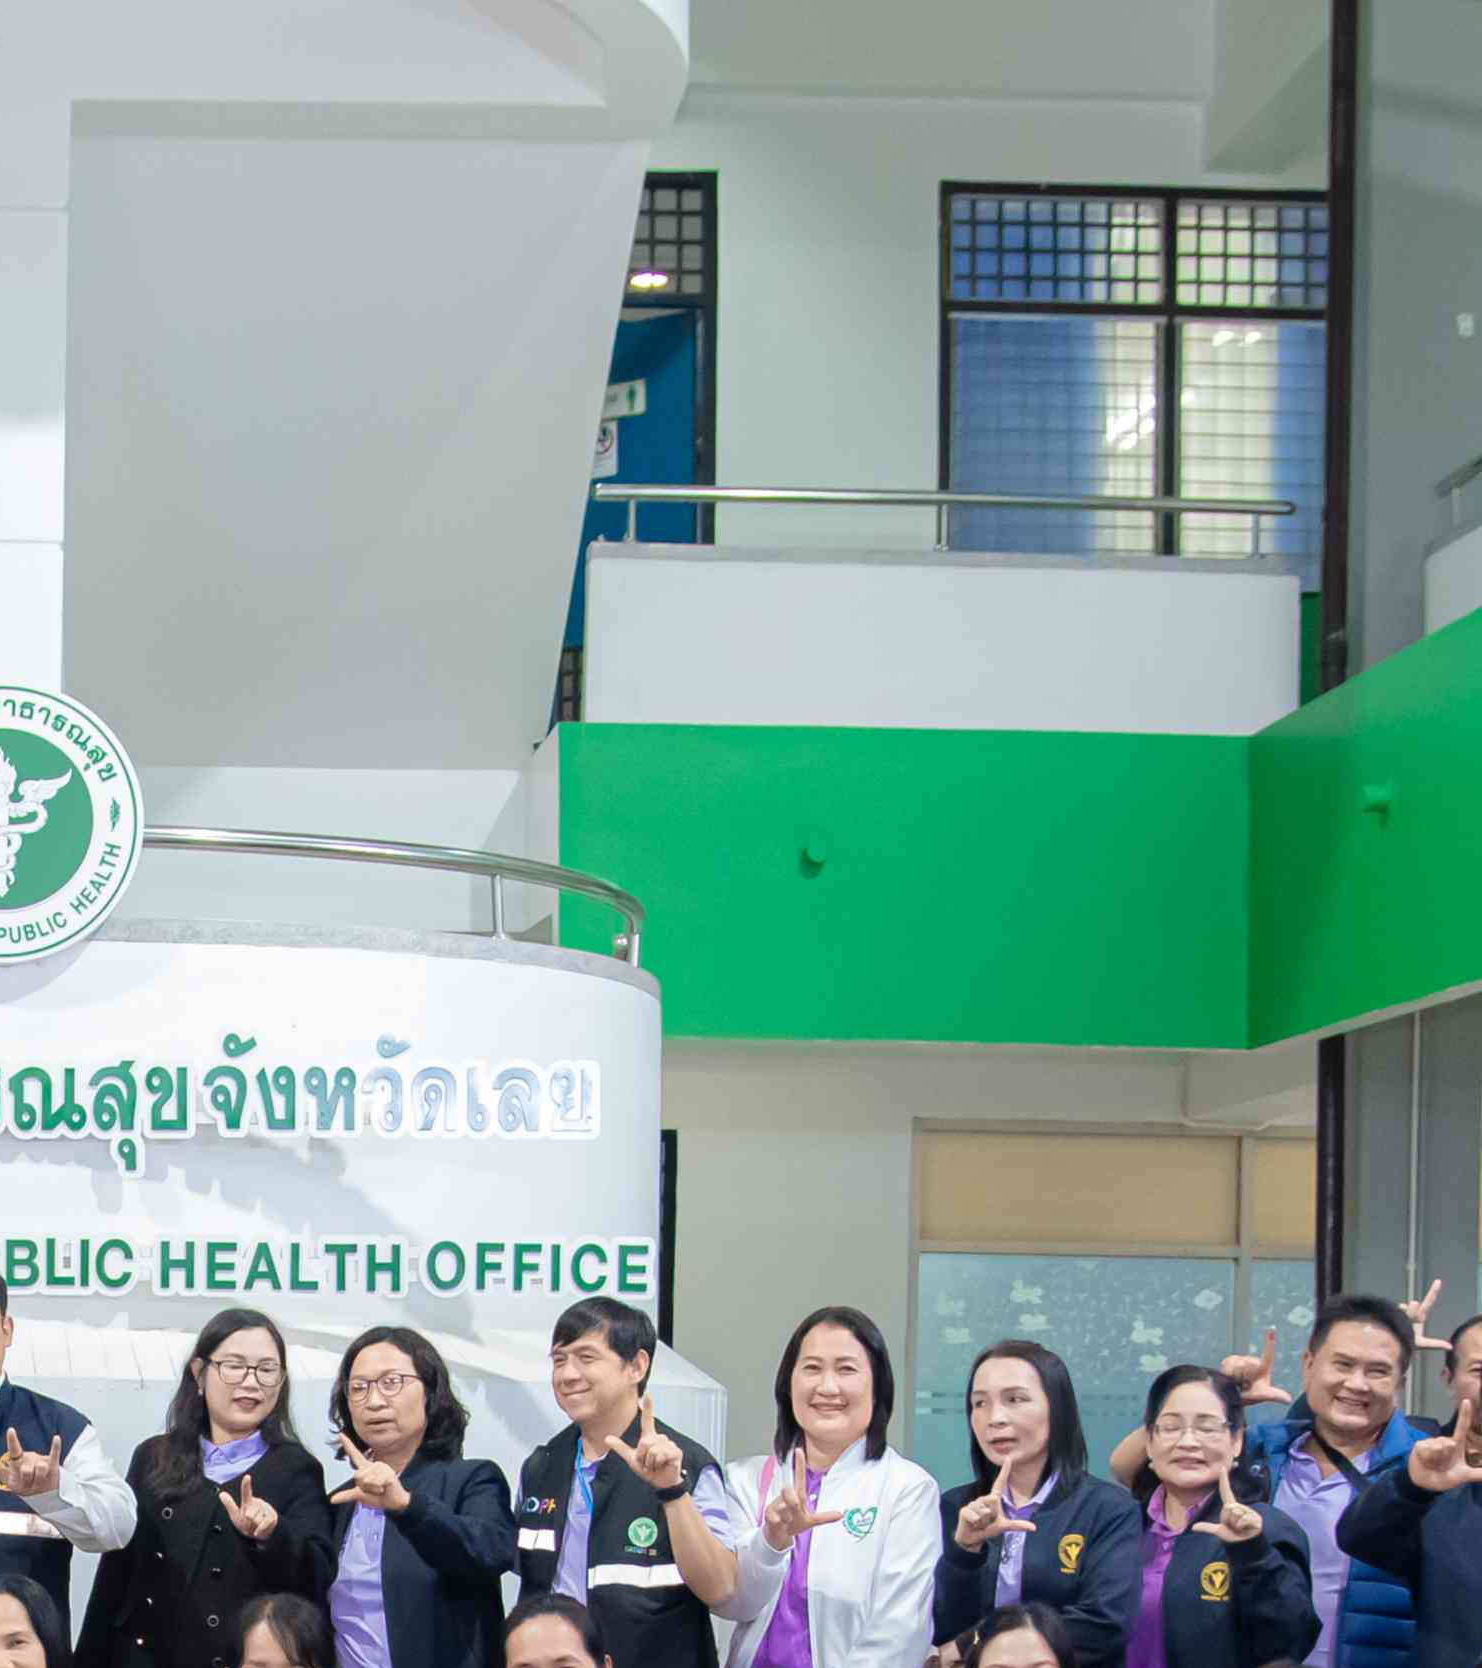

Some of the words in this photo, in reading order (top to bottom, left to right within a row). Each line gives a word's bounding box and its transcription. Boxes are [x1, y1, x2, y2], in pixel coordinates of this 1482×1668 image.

[69, 842, 122, 916] HEALTH
[159, 1240, 401, 1293] HEALTH
[427, 1241, 650, 1293] OFFICE
